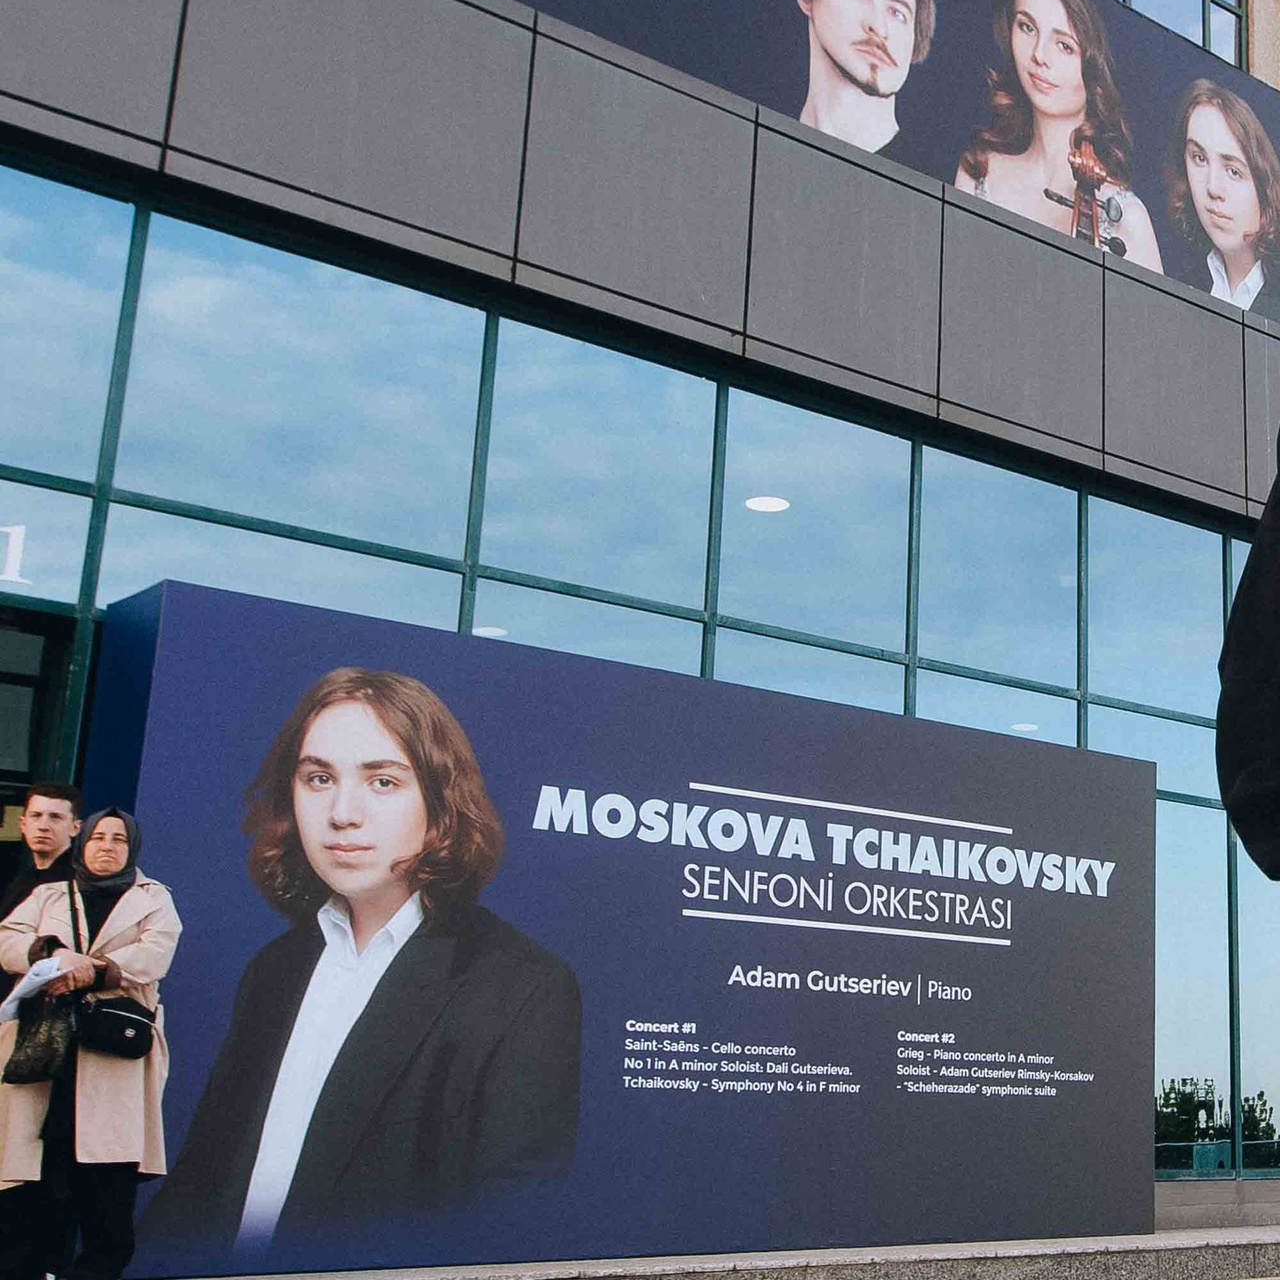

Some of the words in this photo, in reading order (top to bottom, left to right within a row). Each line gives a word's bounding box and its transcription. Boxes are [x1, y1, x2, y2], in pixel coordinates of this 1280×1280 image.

[532, 785, 815, 861] MOSKOVA
[827, 823, 1116, 897] TCHAIKOVSKY
[682, 864, 833, 911] SENFONİ
[844, 882, 1011, 929] ORKESTRASI
[727, 965, 800, 989] Adam
[807, 971, 912, 996] Gutseriev
[928, 980, 972, 1001] Piano
[626, 1020, 679, 1033] Concert
[681, 1022, 696, 1034] #1
[897, 1031, 940, 1043] Concert
[941, 1033, 955, 1043] #2
[711, 1042, 742, 1054] Cello
[744, 1045, 796, 1056] concerto
[897, 1047, 924, 1061] Grieg
[934, 1049, 961, 1060] Piano
[963, 1052, 1006, 1062] concerto
[1007, 1052, 1016, 1063] in
[1018, 1053, 1026, 1063] A
[1027, 1053, 1054, 1064] minor
[624, 1057, 643, 1069] No
[646, 1058, 651, 1069] 1
[654, 1057, 666, 1070] in
[668, 1059, 679, 1070] A
[681, 1059, 718, 1071] minor
[720, 1060, 763, 1073] Soloist:
[766, 1062, 788, 1073] Dali
[791, 1063, 853, 1075] Gutserieva.
[896, 1064, 931, 1076] Soloist
[939, 1066, 969, 1077] Adam
[971, 1067, 1016, 1079] Gutseriev
[1017, 1068, 1094, 1082] Rimsky-Korsakov
[623, 1076, 700, 1092] Tchaikovsky
[711, 1078, 775, 1093] Symphony
[777, 1080, 794, 1091] No
[796, 1081, 804, 1092] 4
[806, 1080, 816, 1092] in
[819, 1081, 827, 1092] F
[829, 1082, 861, 1093] minor
[982, 1084, 1033, 1097] symphonic
[1034, 1085, 1057, 1096] suite
